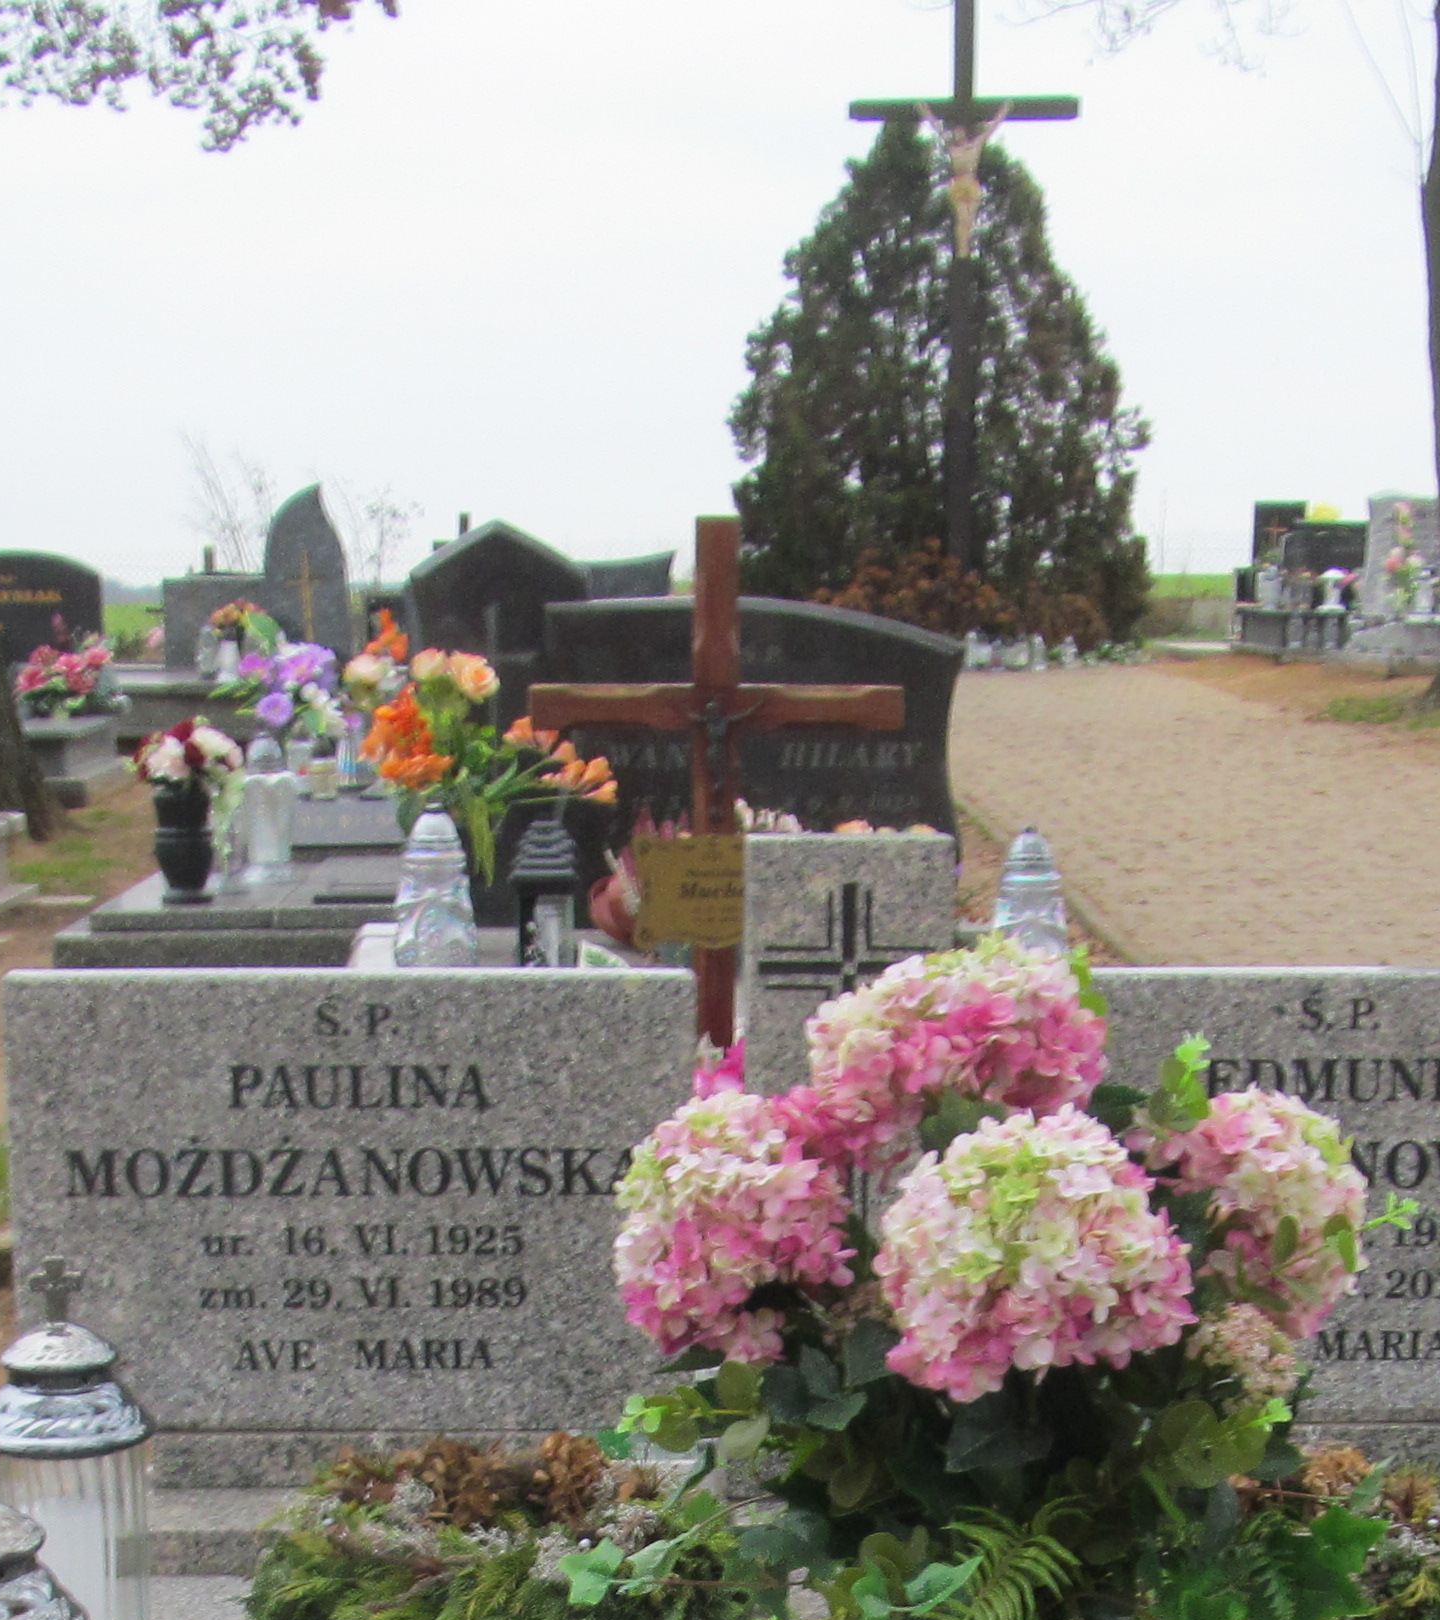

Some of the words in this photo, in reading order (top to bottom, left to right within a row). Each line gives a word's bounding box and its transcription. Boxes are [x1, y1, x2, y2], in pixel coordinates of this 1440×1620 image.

[229, 1063, 494, 1110] PAULINA
[200, 1235, 253, 1257] ur.
[282, 1225, 336, 1257] 16.
[356, 1223, 408, 1256] VI.
[426, 1225, 523, 1256] 1925
[200, 1287, 267, 1309] zm.
[282, 1278, 342, 1310] 29.
[429, 1277, 528, 1309] 1989
[233, 1339, 316, 1372] AVE
[353, 1338, 494, 1370] MARIA
